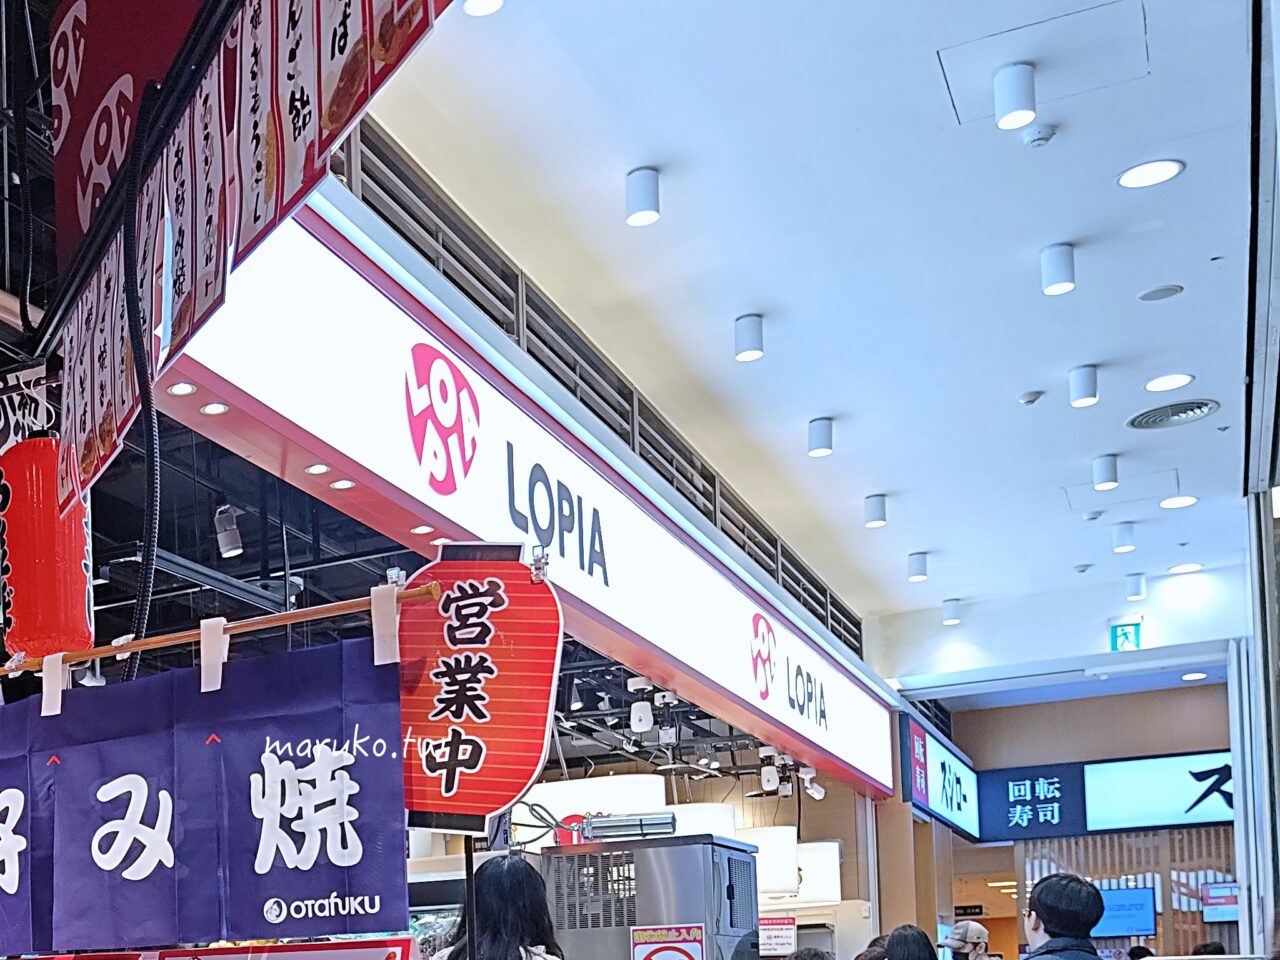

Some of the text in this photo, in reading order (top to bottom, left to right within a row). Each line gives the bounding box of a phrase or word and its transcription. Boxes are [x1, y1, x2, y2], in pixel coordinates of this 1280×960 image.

[506, 441, 609, 587] LOPIA
[425, 577, 509, 797] 営業中
[786, 655, 828, 731] LOPIA
[1008, 777, 1061, 803] 回転
[1008, 802, 1061, 828] 寿司
